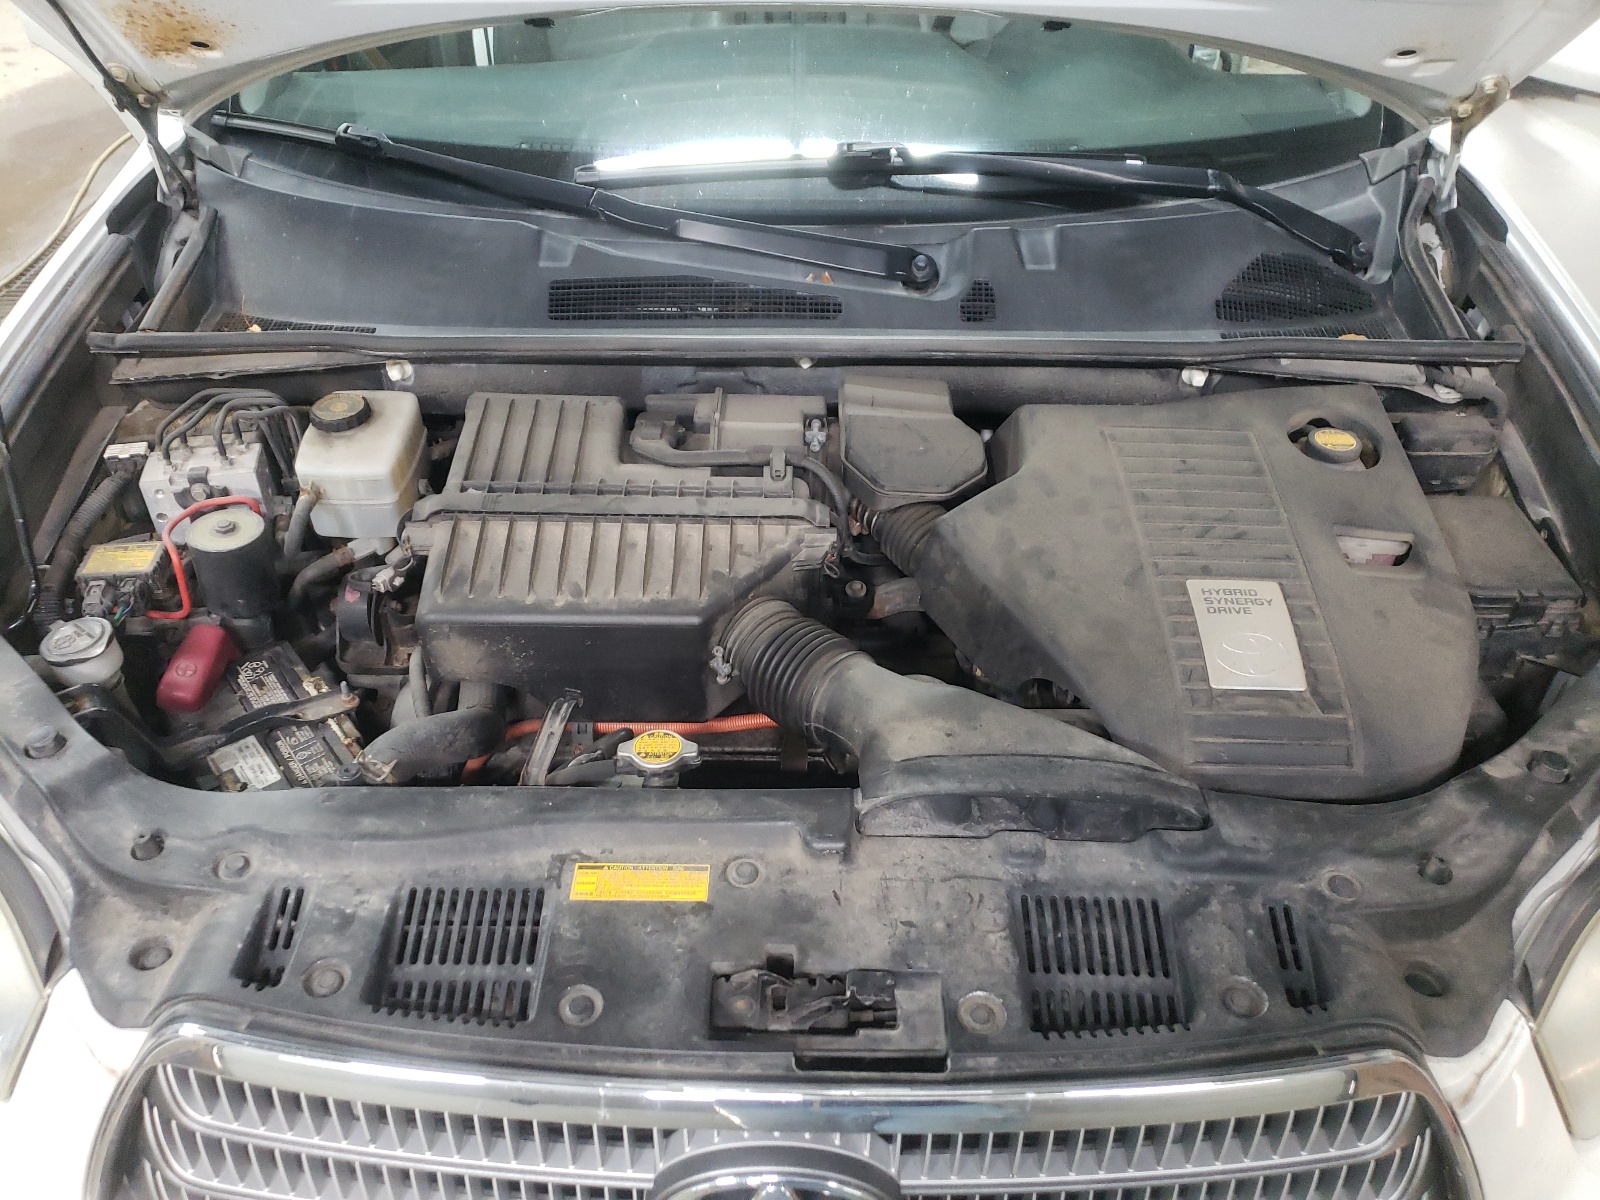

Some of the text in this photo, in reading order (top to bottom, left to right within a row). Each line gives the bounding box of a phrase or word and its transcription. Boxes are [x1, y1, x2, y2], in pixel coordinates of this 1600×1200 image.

[1201, 588, 1258, 597] HYBRID
[1203, 597, 1274, 606] SYNERGY
[1206, 606, 1253, 615] DRIVE
